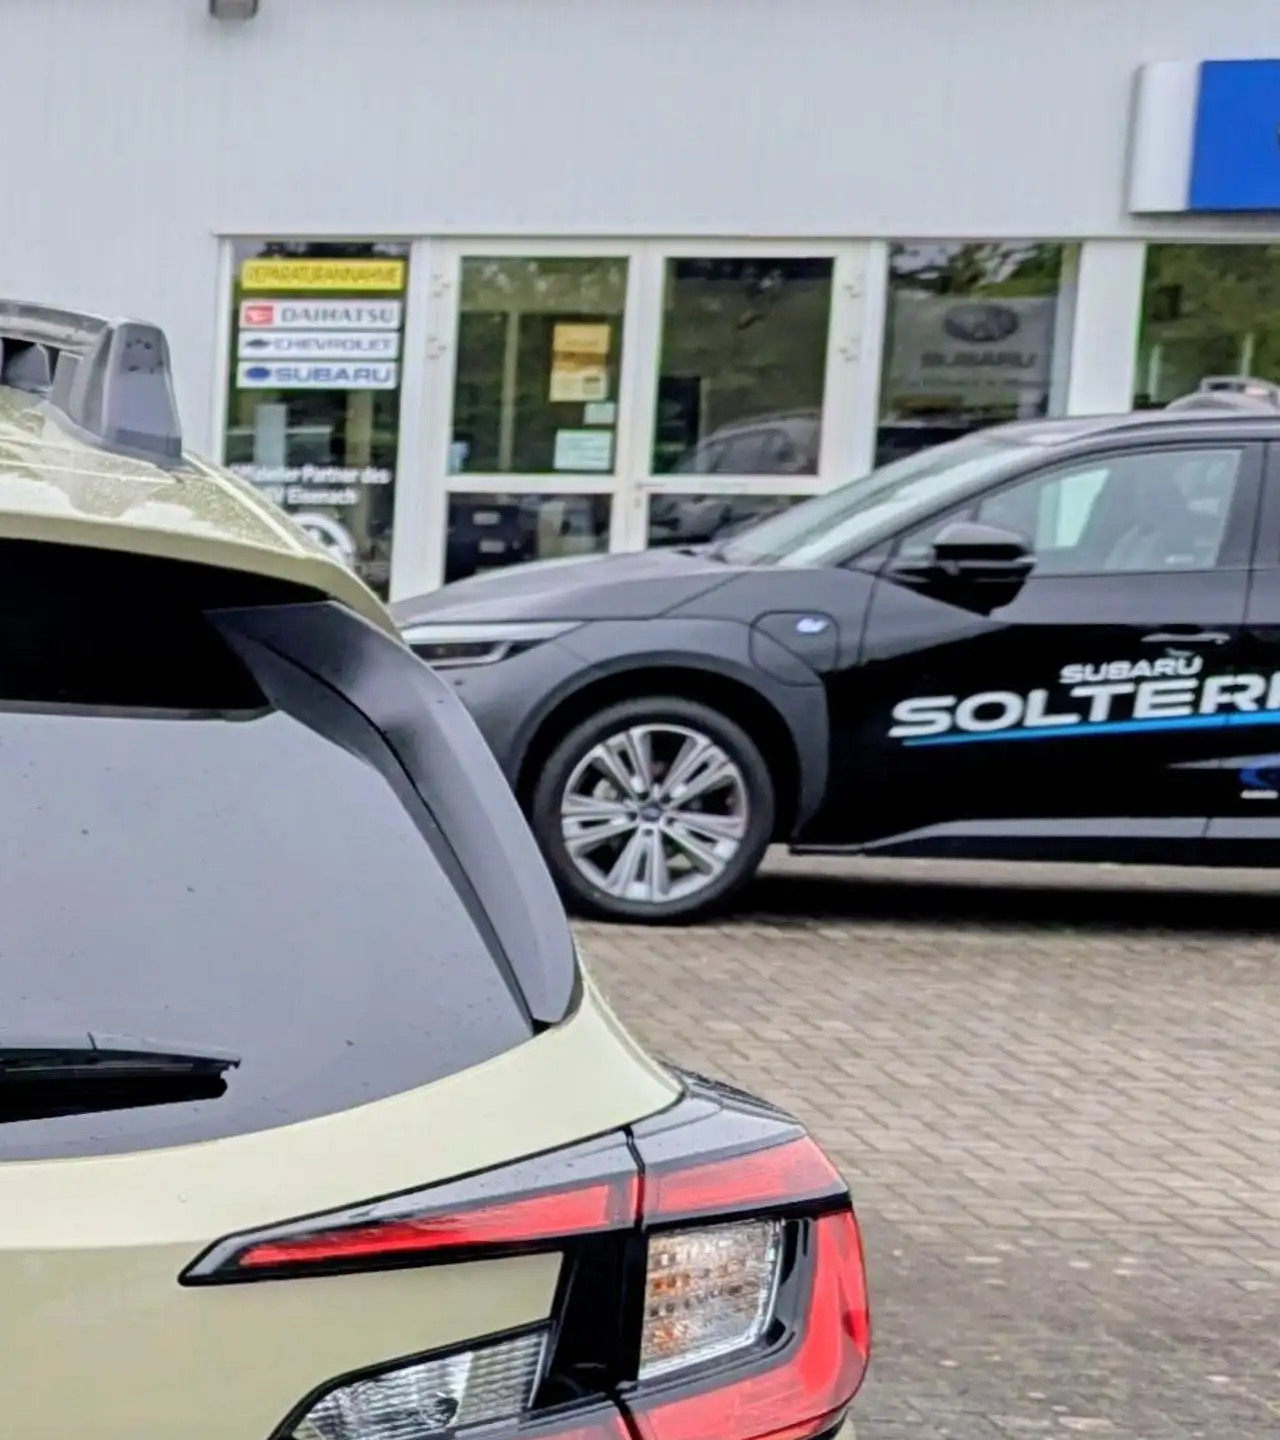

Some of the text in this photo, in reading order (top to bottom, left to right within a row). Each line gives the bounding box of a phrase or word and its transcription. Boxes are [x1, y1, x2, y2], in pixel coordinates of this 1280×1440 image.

[281, 306, 394, 323] DAIHATSU
[274, 339, 392, 351] CHEVROLET
[274, 366, 391, 382] SUBARU
[1059, 656, 1204, 684] SUBARU
[887, 671, 1280, 738] SOLTER
